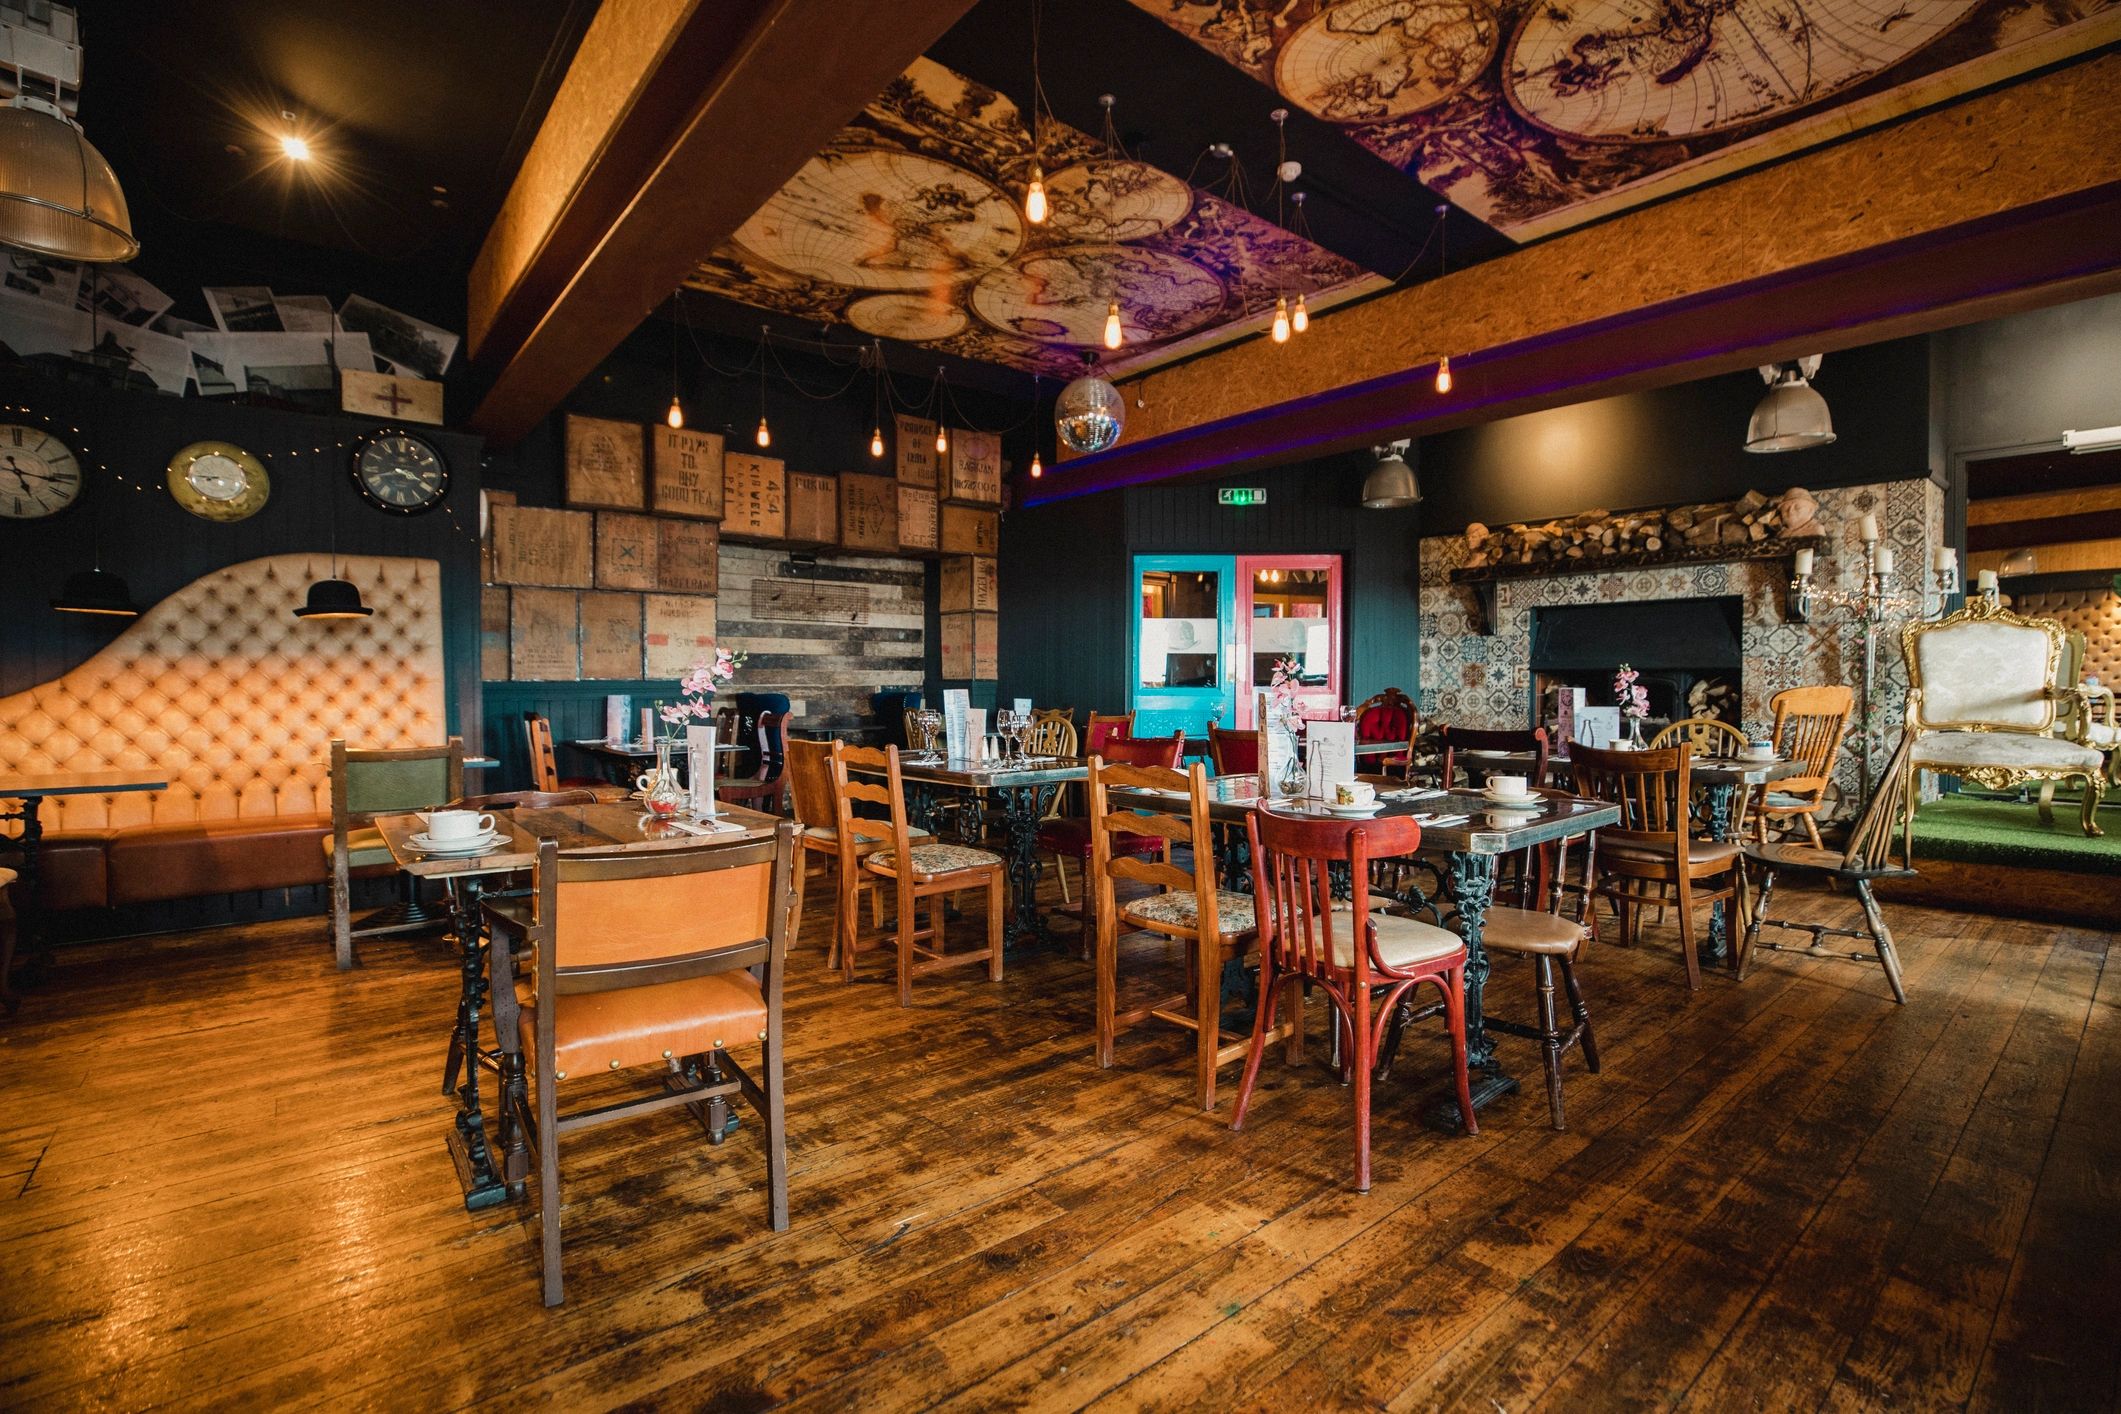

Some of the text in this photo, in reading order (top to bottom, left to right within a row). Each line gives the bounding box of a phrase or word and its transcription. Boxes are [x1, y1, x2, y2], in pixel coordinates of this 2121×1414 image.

[668, 433, 709, 453] IT PAYS
[678, 470, 699, 487] BUY
[661, 484, 713, 505] GOOD TEA
